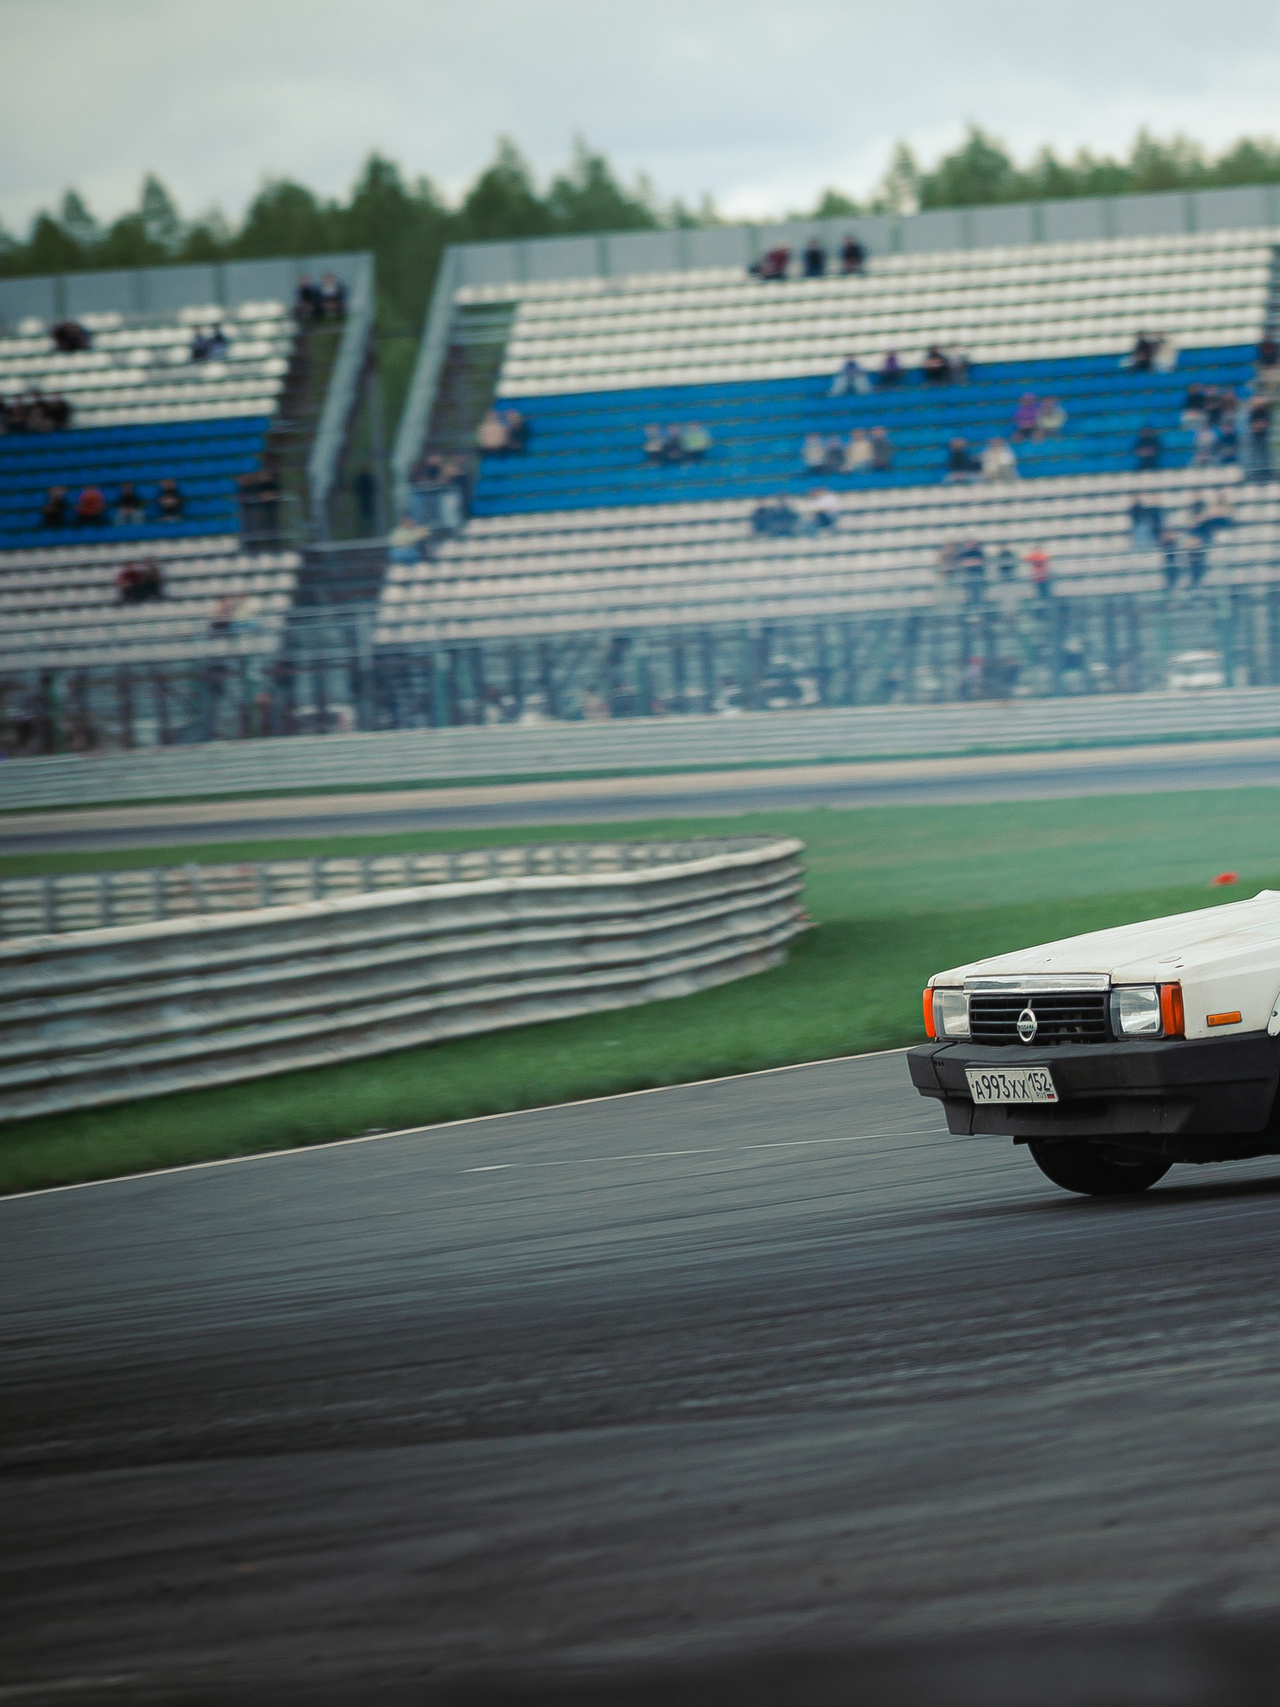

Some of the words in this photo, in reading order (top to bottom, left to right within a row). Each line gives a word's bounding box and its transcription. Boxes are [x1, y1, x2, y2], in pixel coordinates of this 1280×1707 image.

[974, 1074, 1030, 1099] A993XX
[1028, 1072, 1050, 1091] 152
[1036, 1091, 1047, 1099] RUS
